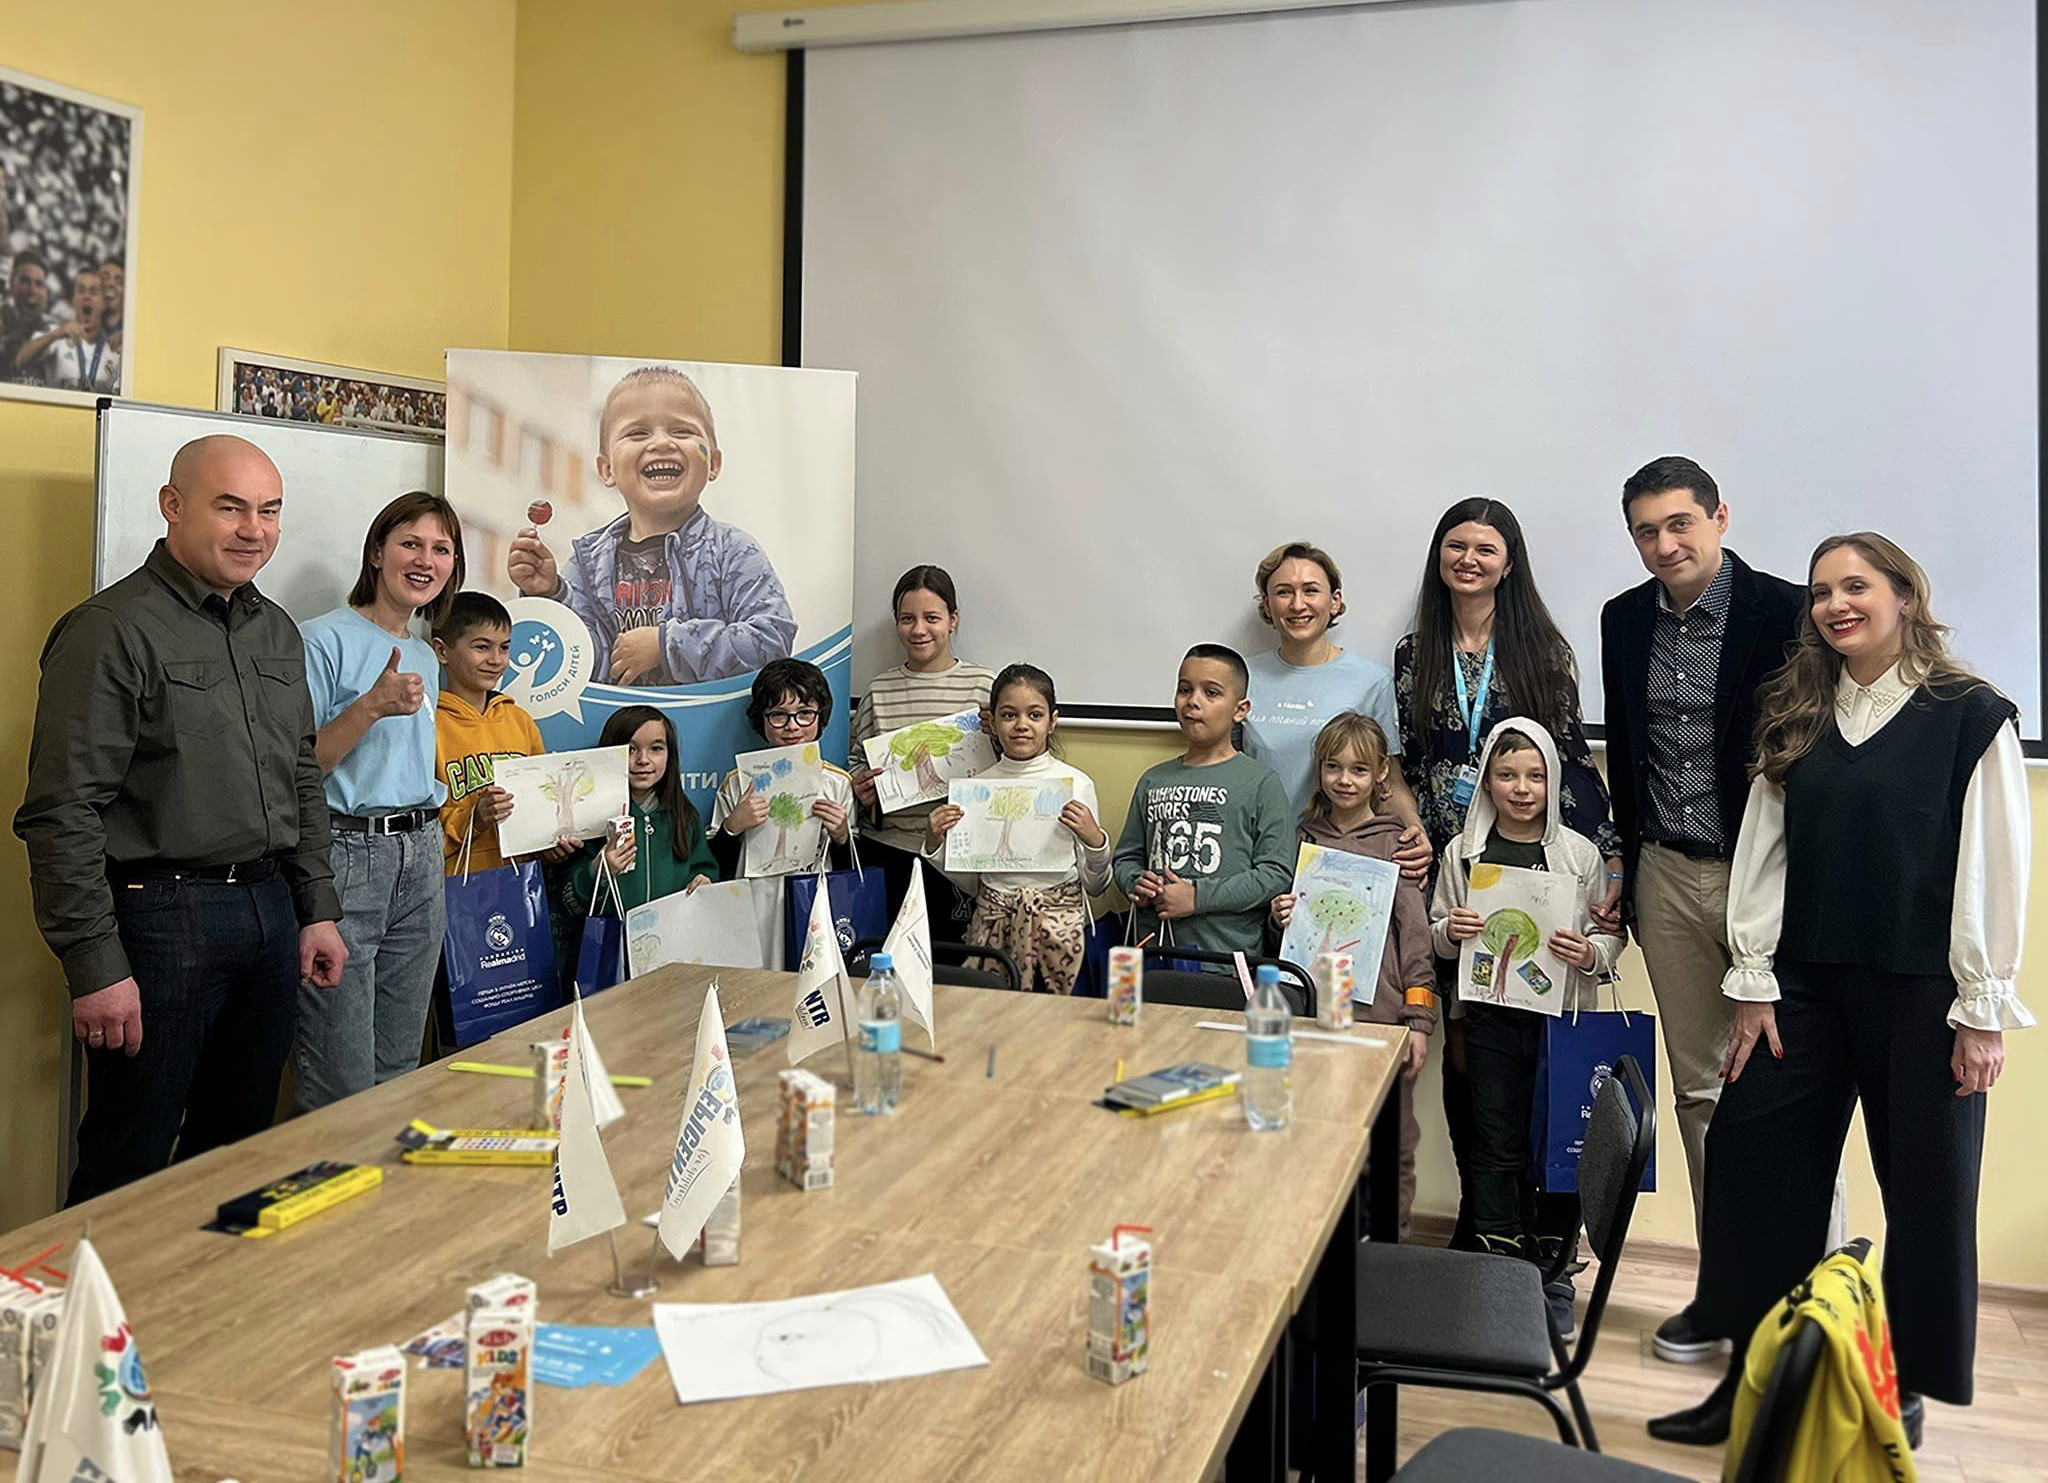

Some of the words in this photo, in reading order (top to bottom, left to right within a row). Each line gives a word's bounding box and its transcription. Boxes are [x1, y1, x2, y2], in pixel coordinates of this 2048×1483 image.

[529, 677, 570, 703] ГОЛОСИ
[568, 645, 580, 678] ДІТЕЙ
[1147, 802, 1191, 823] STORES
